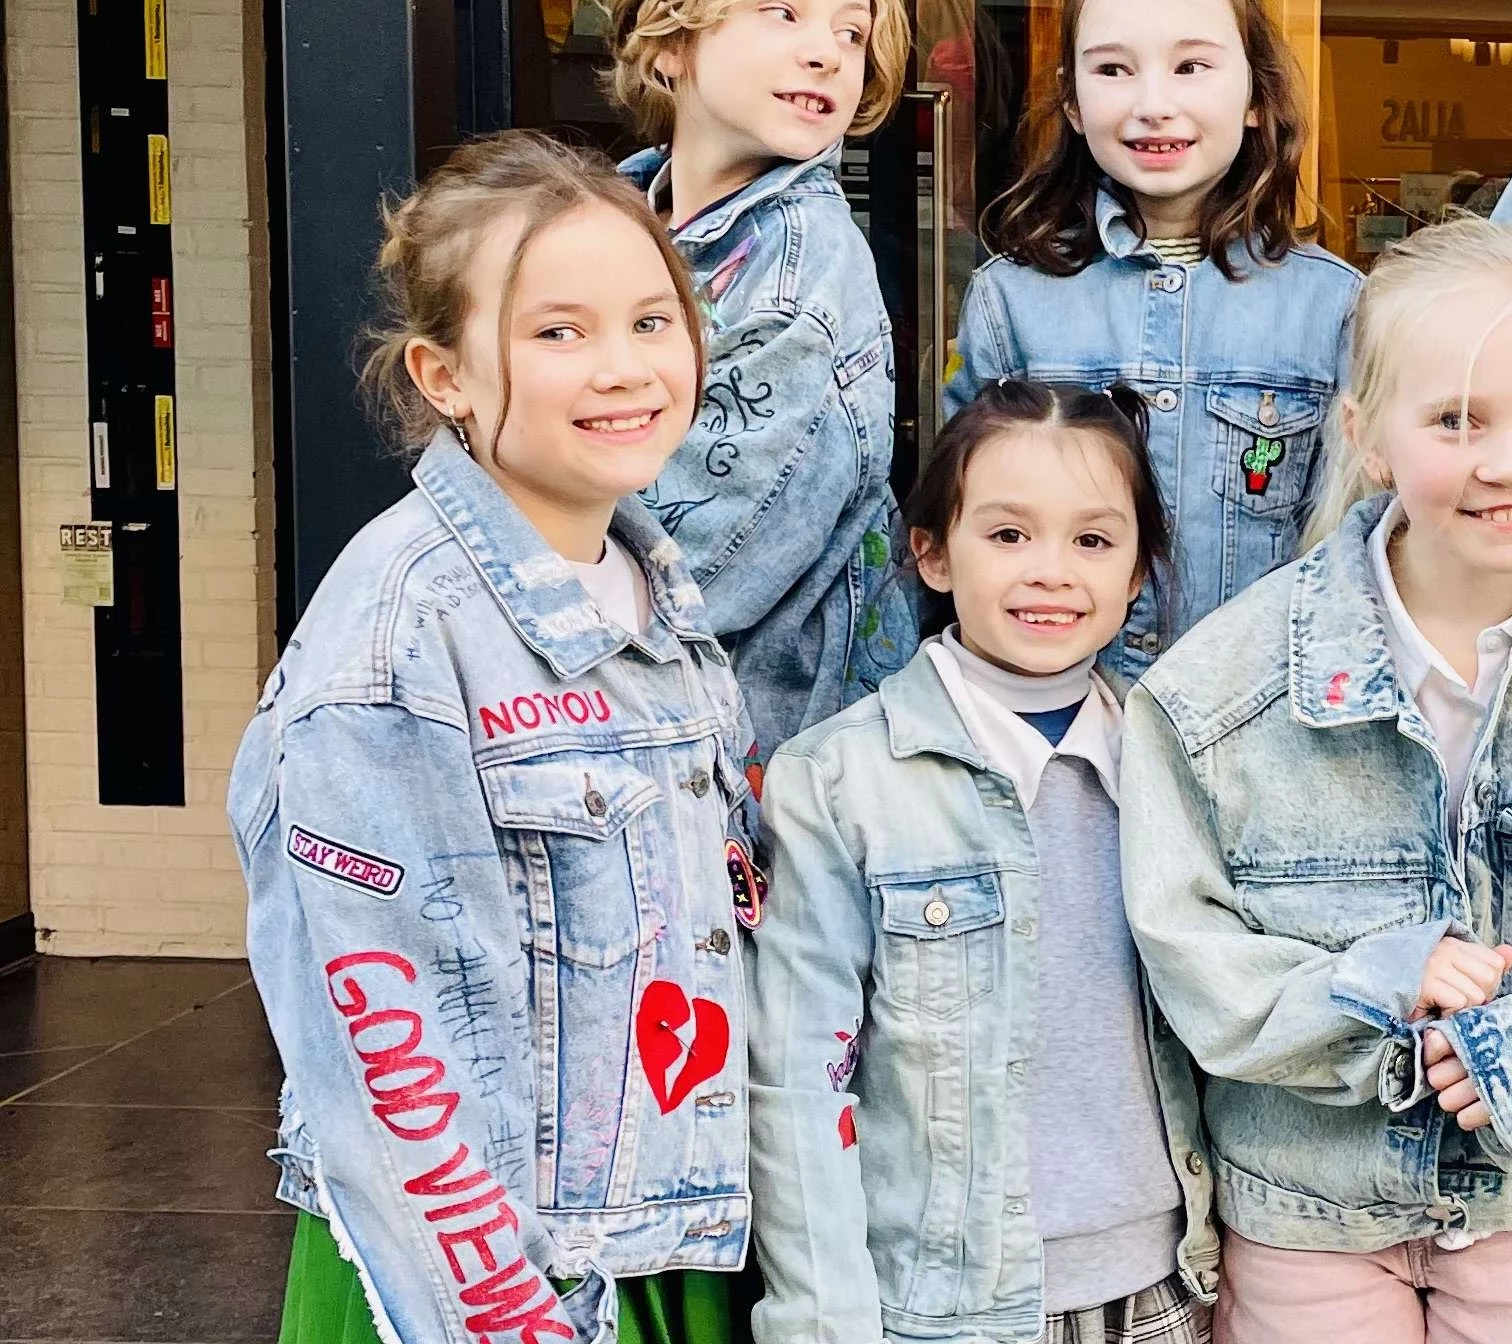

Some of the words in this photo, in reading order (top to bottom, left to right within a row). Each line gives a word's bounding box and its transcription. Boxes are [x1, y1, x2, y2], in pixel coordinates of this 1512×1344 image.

[61, 529, 112, 545] REST
[293, 833, 335, 865] STAY
[325, 951, 462, 1142] GOOD
